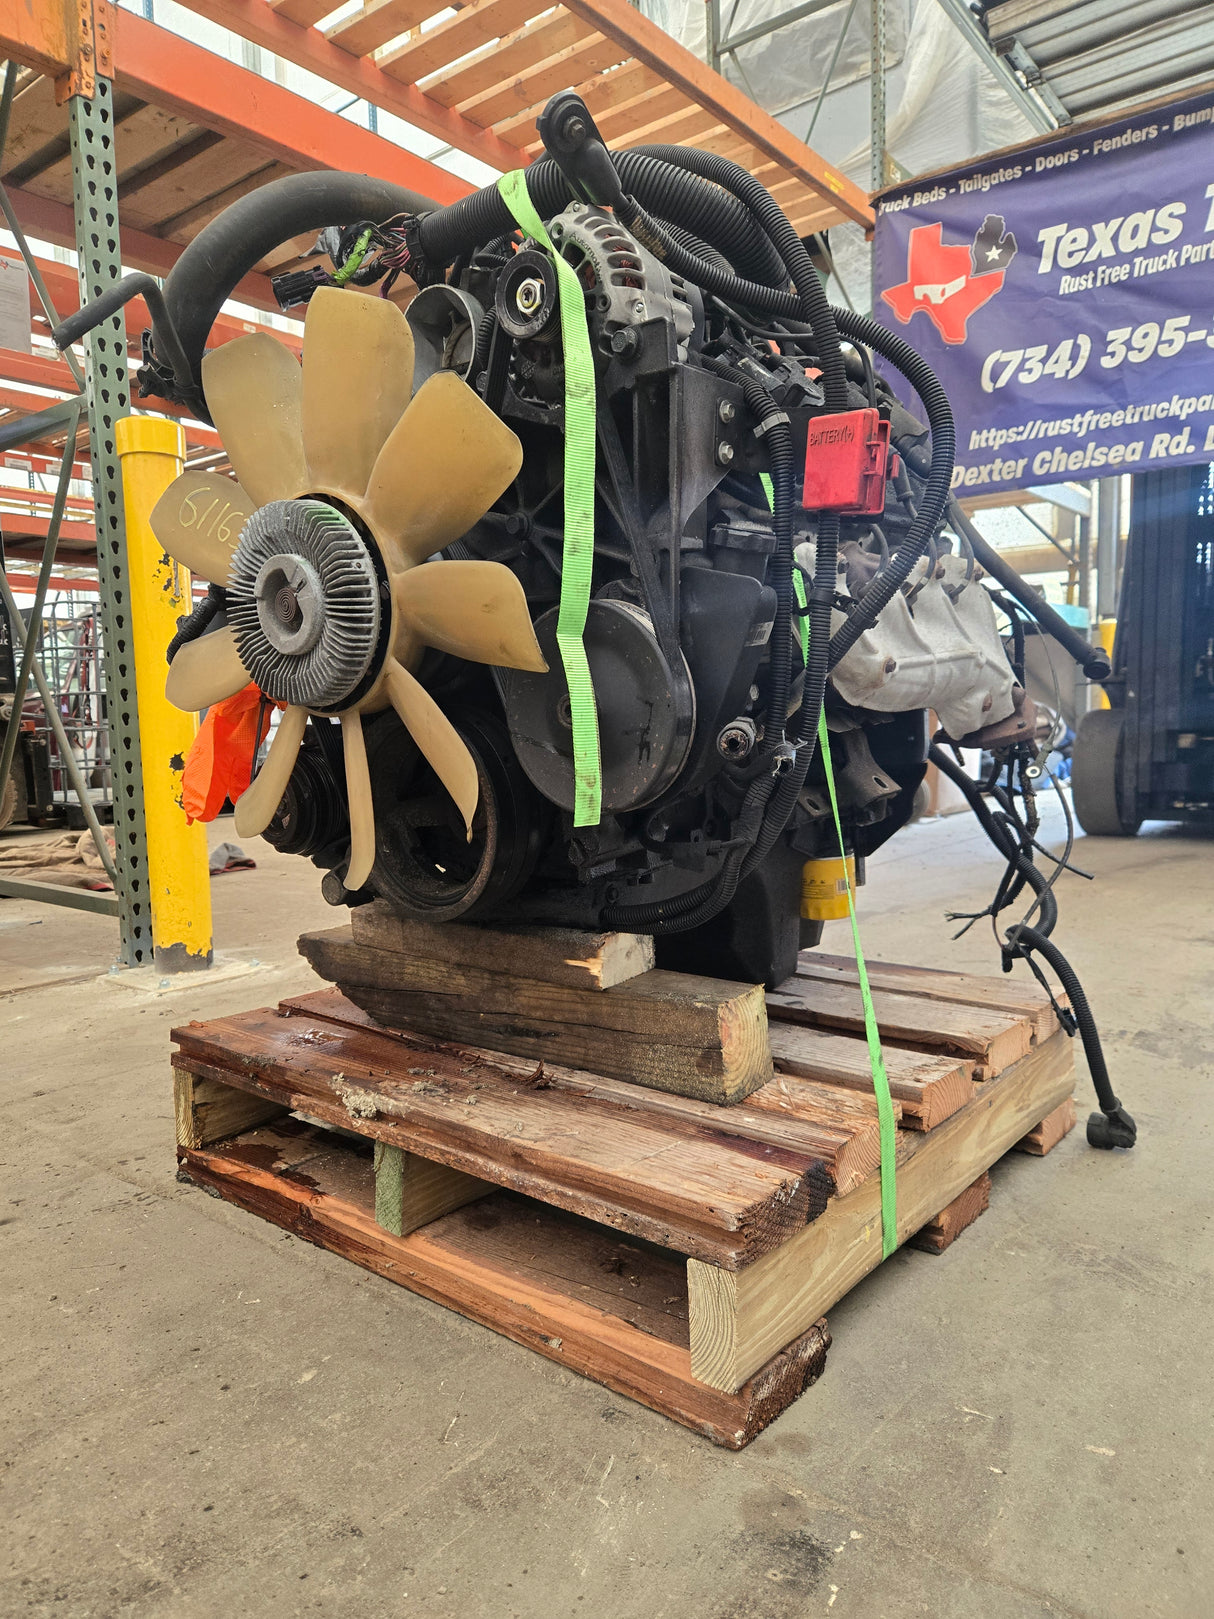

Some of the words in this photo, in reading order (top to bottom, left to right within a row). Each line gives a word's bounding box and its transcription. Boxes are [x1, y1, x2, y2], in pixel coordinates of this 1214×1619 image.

[912, 186, 947, 208] Beds
[958, 165, 1022, 195] Tailgates
[1035, 148, 1079, 172] Doors
[1093, 123, 1158, 156] Fenders
[1037, 201, 1187, 275] Texas
[1059, 269, 1095, 295] Rust
[1096, 262, 1130, 287] Free
[1133, 249, 1178, 277] Truck
[981, 334, 1091, 393] (734)
[951, 457, 1029, 489] Dexter
[1032, 441, 1144, 475] Chelsea
[1149, 426, 1196, 459] Rd.
